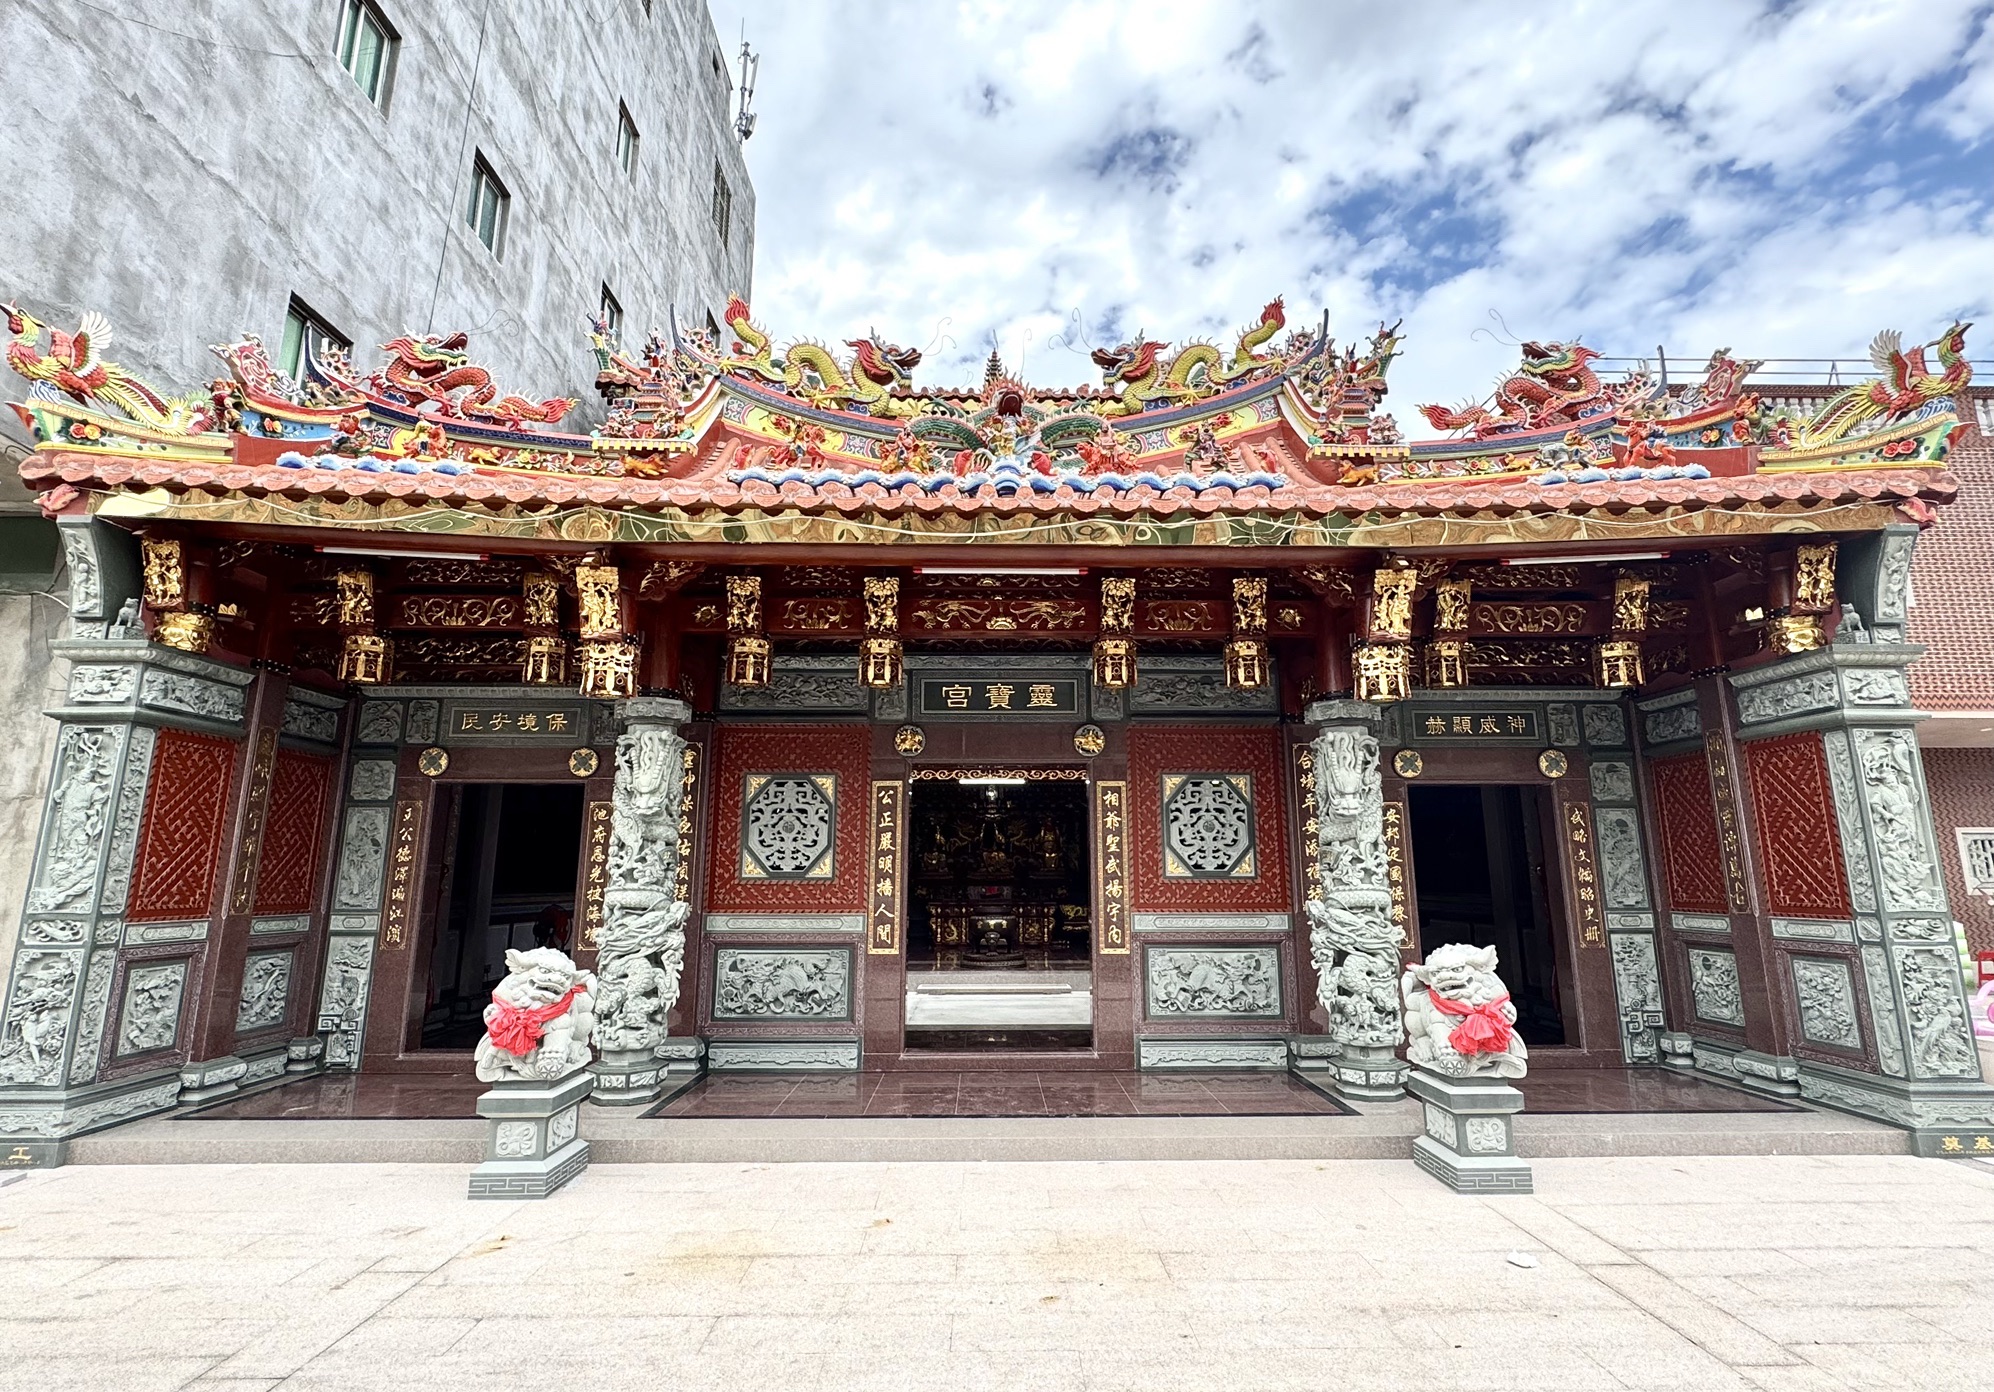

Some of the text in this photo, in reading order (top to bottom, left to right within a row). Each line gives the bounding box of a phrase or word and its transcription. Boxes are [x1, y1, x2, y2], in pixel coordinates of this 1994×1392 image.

[942, 683, 1058, 709] 靈寶宮
[462, 713, 569, 732] 保境安民
[1425, 715, 1526, 735] 神威顯赫
[874, 790, 896, 945] 公正嚴明播人間
[1383, 808, 1409, 943] 安邦定國保黎
[8, 1146, 32, 1160] 工
[1941, 1135, 1994, 1151] 奠基
